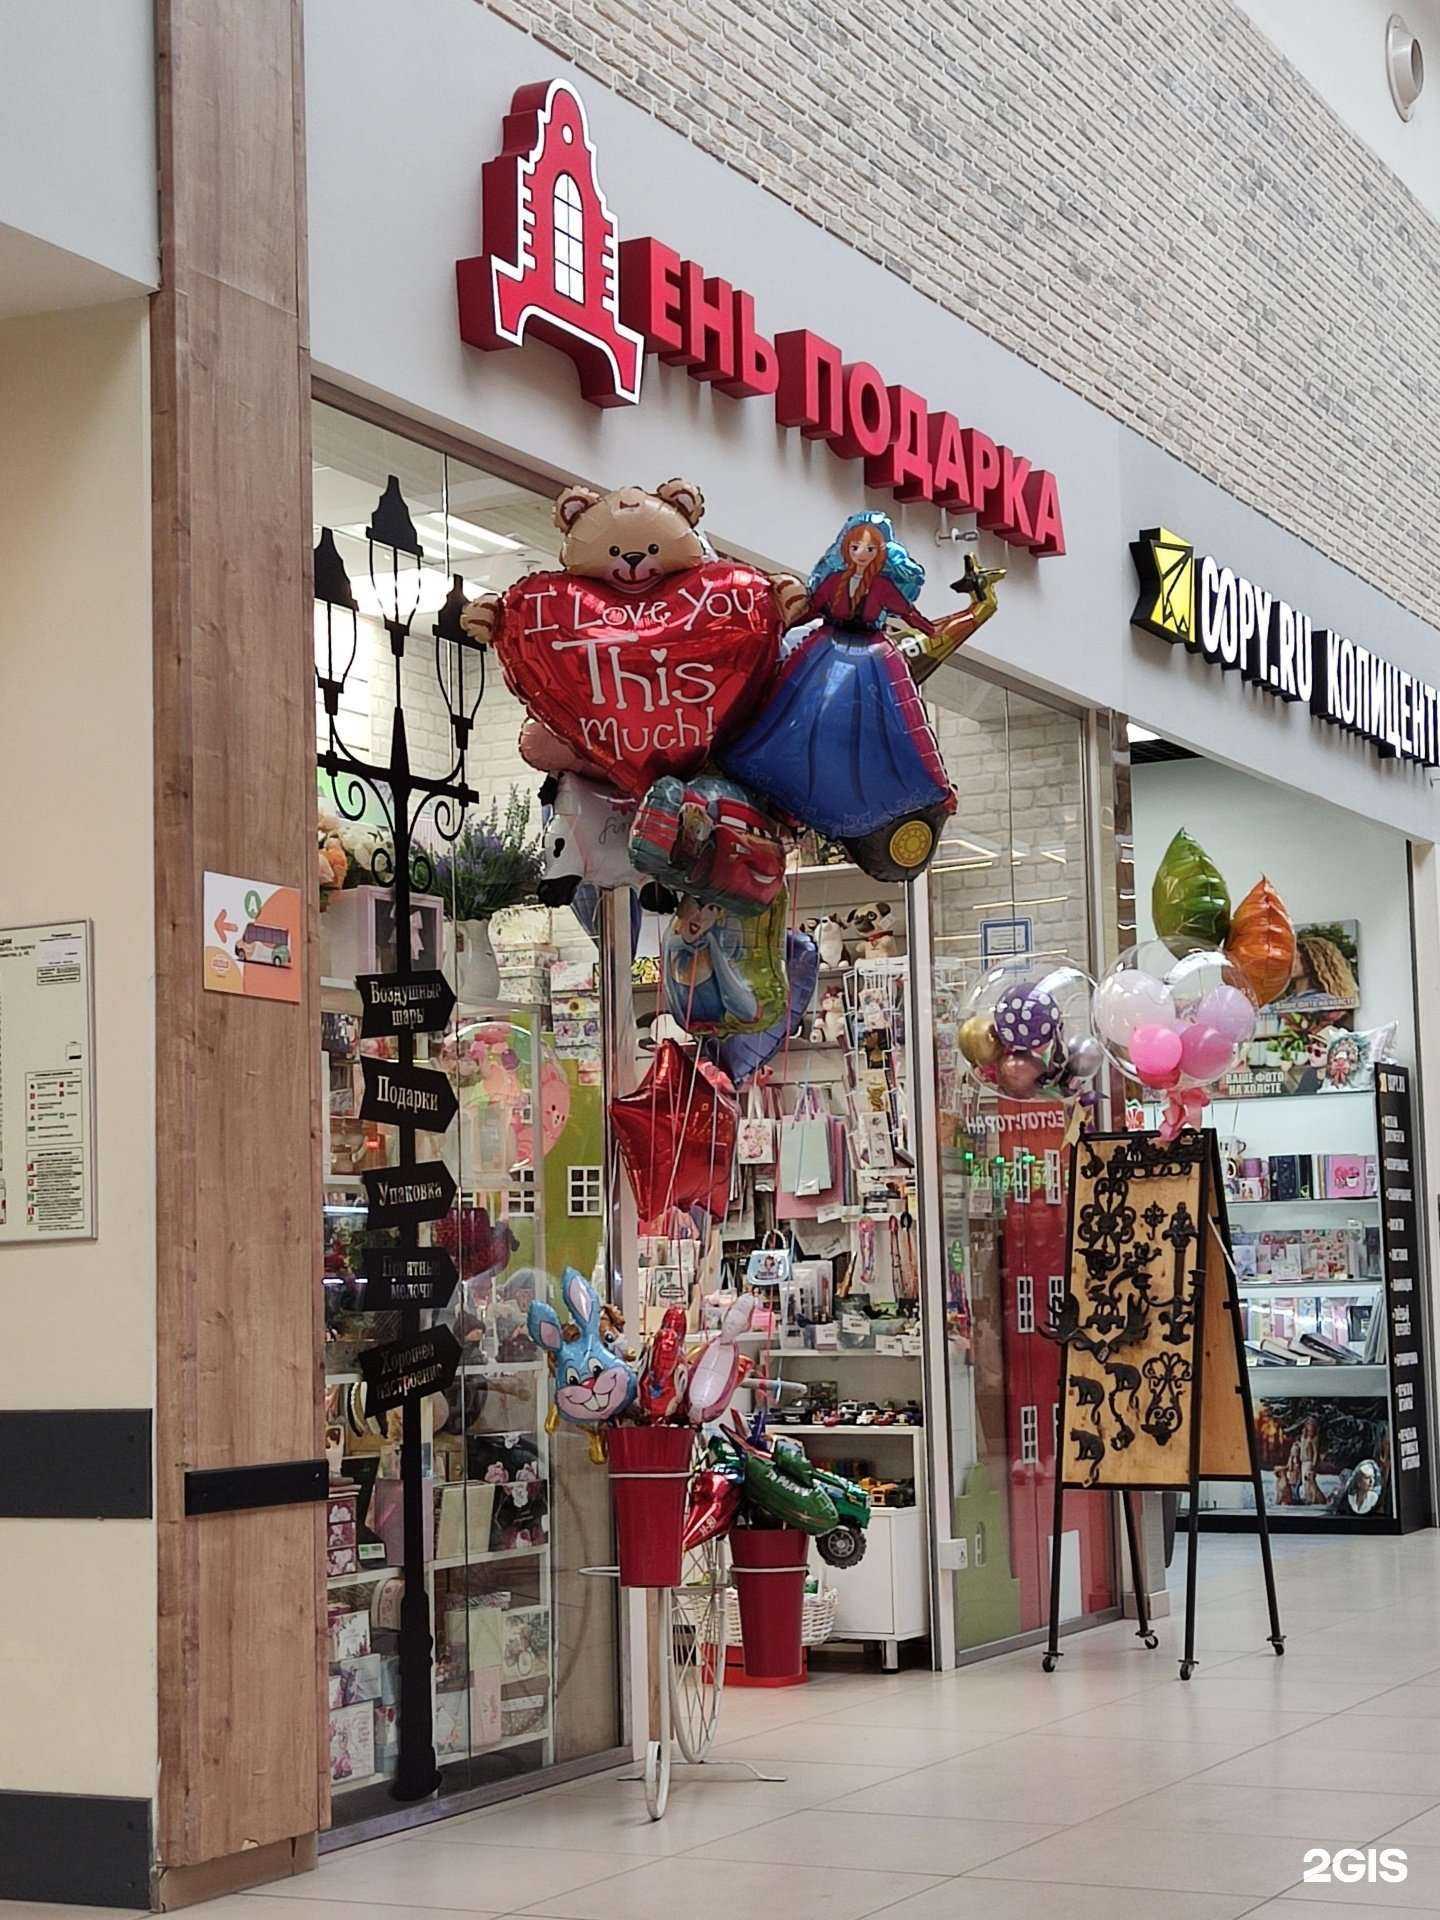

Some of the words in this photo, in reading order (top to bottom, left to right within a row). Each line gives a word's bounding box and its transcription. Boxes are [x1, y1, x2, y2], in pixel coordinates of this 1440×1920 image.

[792, 330, 1067, 556] ПОДАРКА
[523, 589, 560, 635] I
[573, 590, 672, 631] Love
[677, 580, 756, 631] You
[551, 631, 717, 712] This
[1201, 555, 1313, 702] COPY.RU
[1326, 628, 1440, 770] КОПИЦЕНТ
[377, 1075, 439, 1113] Подарки
[1255, 1071, 1284, 1083] ФОТО
[377, 1180, 443, 1207] Упаковка
